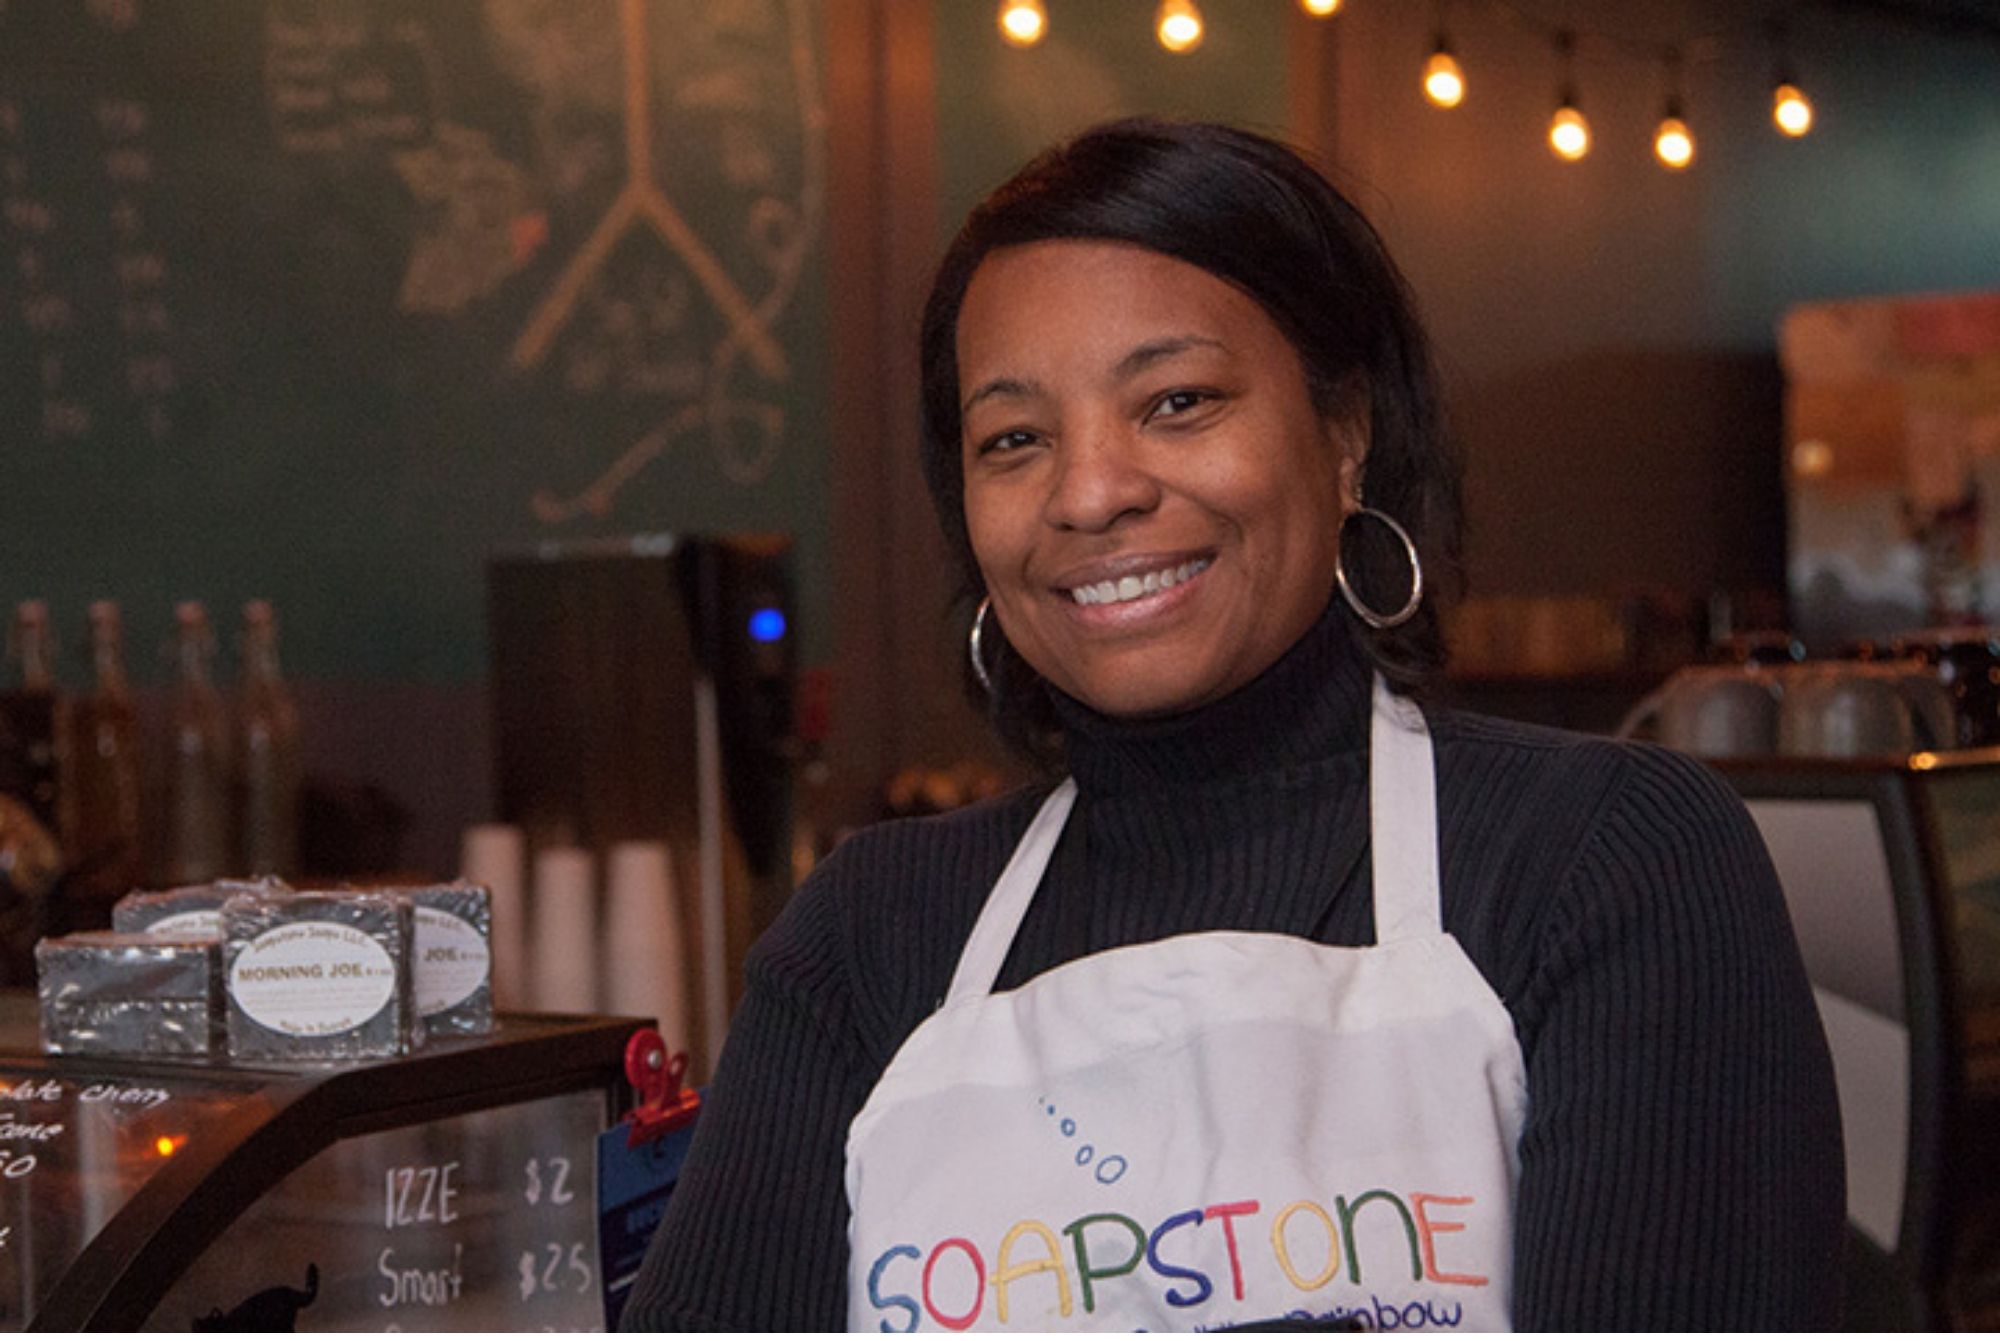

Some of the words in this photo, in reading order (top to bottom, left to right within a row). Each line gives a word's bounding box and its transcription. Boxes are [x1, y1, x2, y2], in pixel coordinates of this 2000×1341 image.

[238, 964, 323, 982] MORNING
[385, 1161, 460, 1229] IZZE
[525, 1157, 574, 1205] $2
[378, 1243, 462, 1307] Smart
